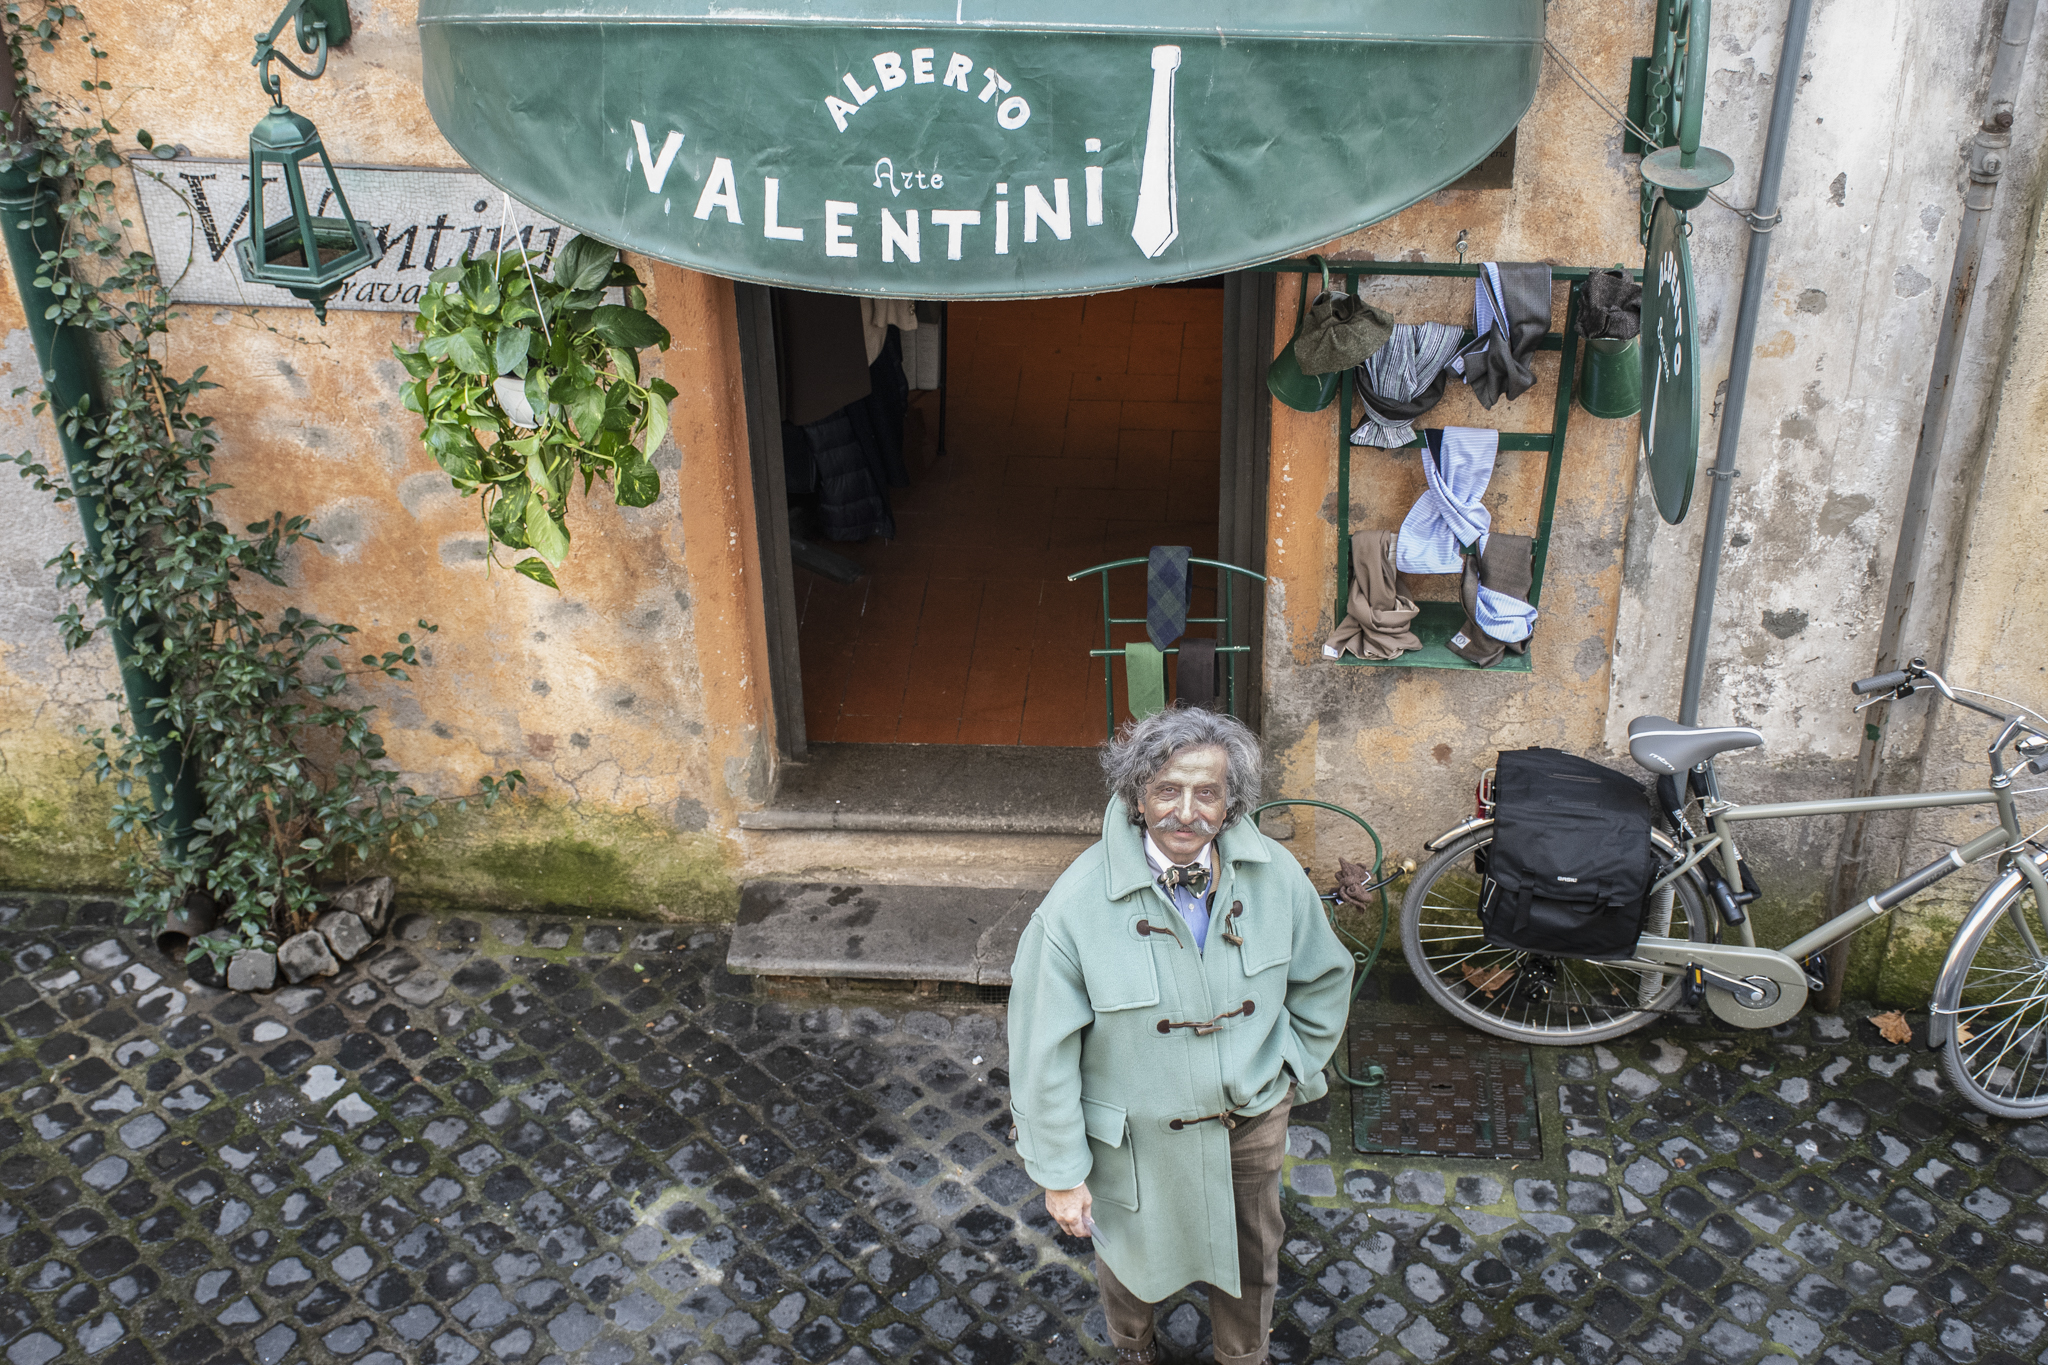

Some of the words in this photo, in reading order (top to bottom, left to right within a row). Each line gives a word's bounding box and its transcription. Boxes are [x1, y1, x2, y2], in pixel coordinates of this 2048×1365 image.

[825, 48, 1031, 132] ALBERTO
[873, 157, 945, 198] Arte
[1658, 251, 1682, 376] ALBERTO
